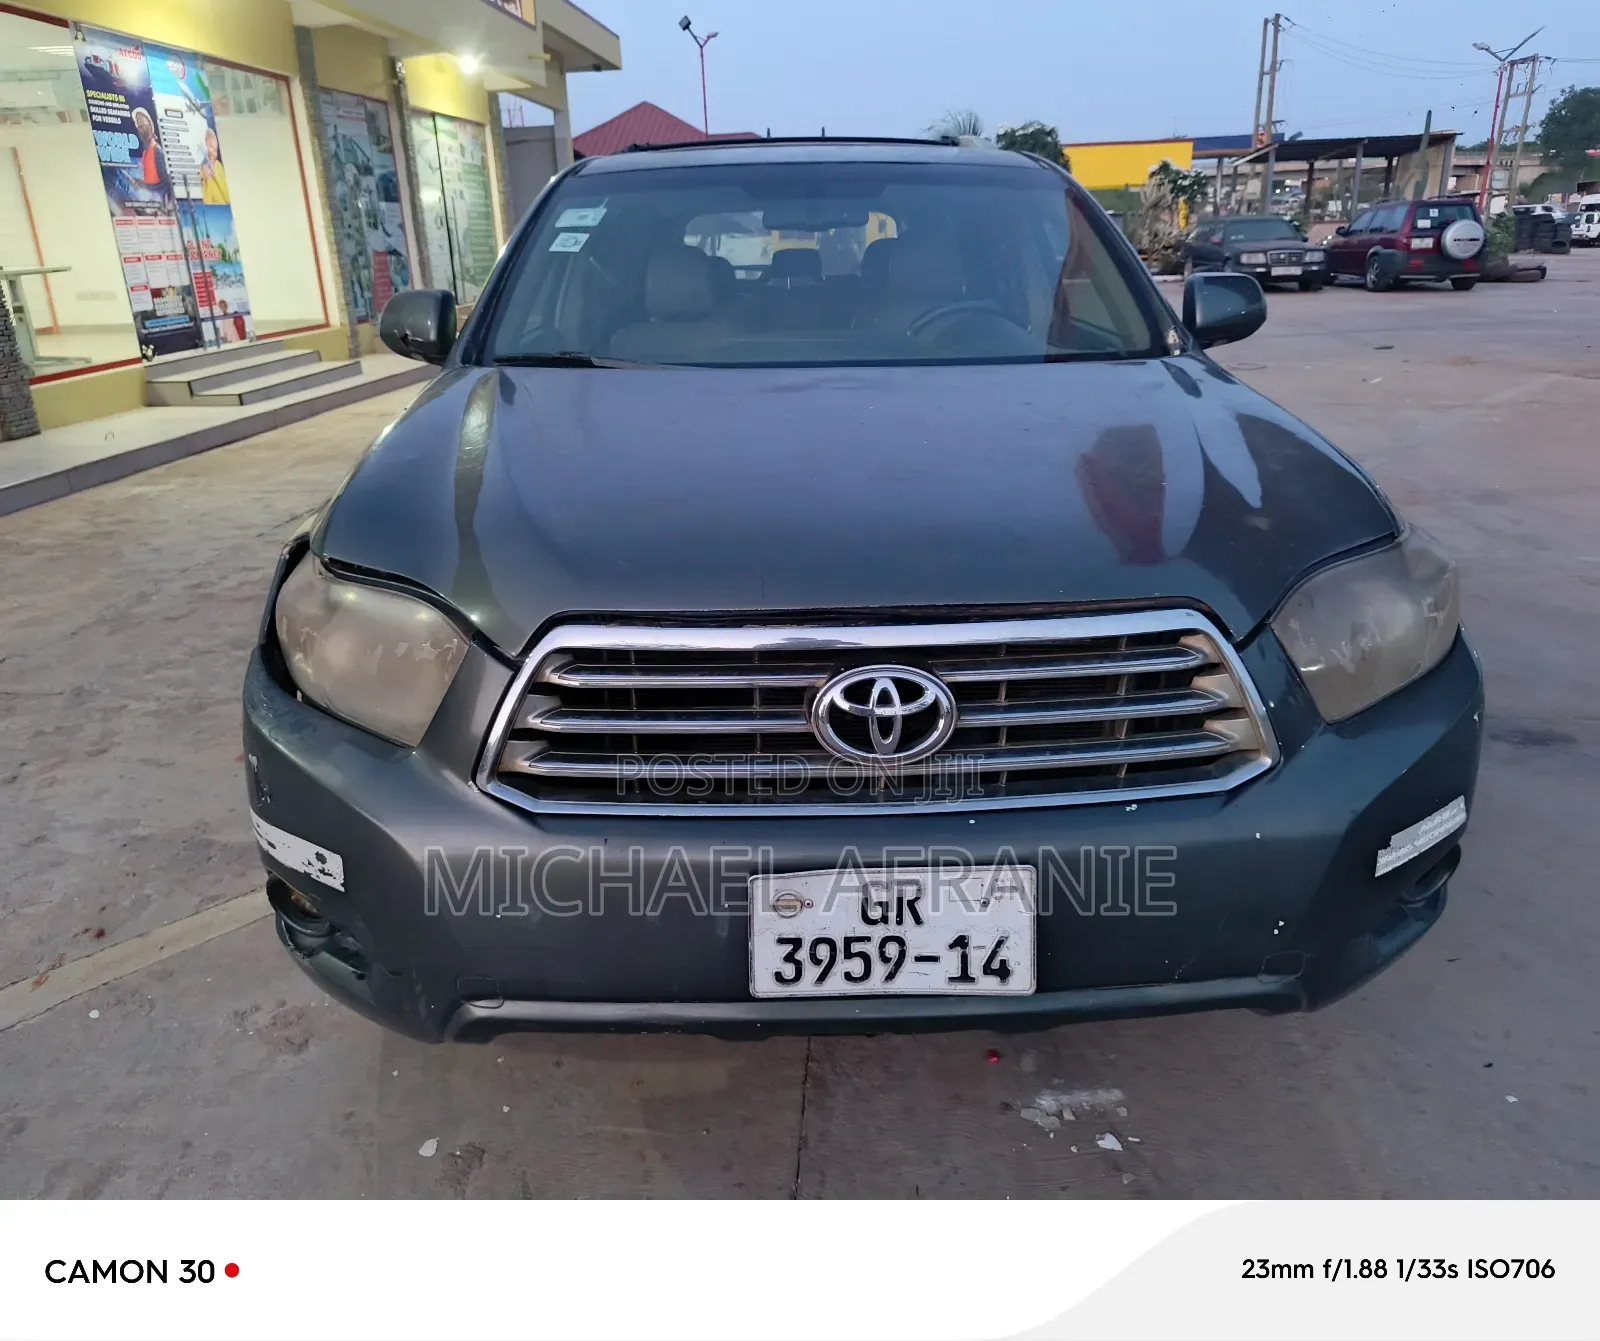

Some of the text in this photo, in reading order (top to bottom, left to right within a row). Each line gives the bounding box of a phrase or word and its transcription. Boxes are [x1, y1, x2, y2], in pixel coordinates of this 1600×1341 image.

[86, 90, 118, 101] SPECIALISTS
[90, 106, 107, 115] SKILLED
[103, 117, 122, 125] VESSELS
[92, 130, 140, 149] WORLD
[860, 878, 926, 927] GR
[773, 933, 1013, 985] 3959-14
